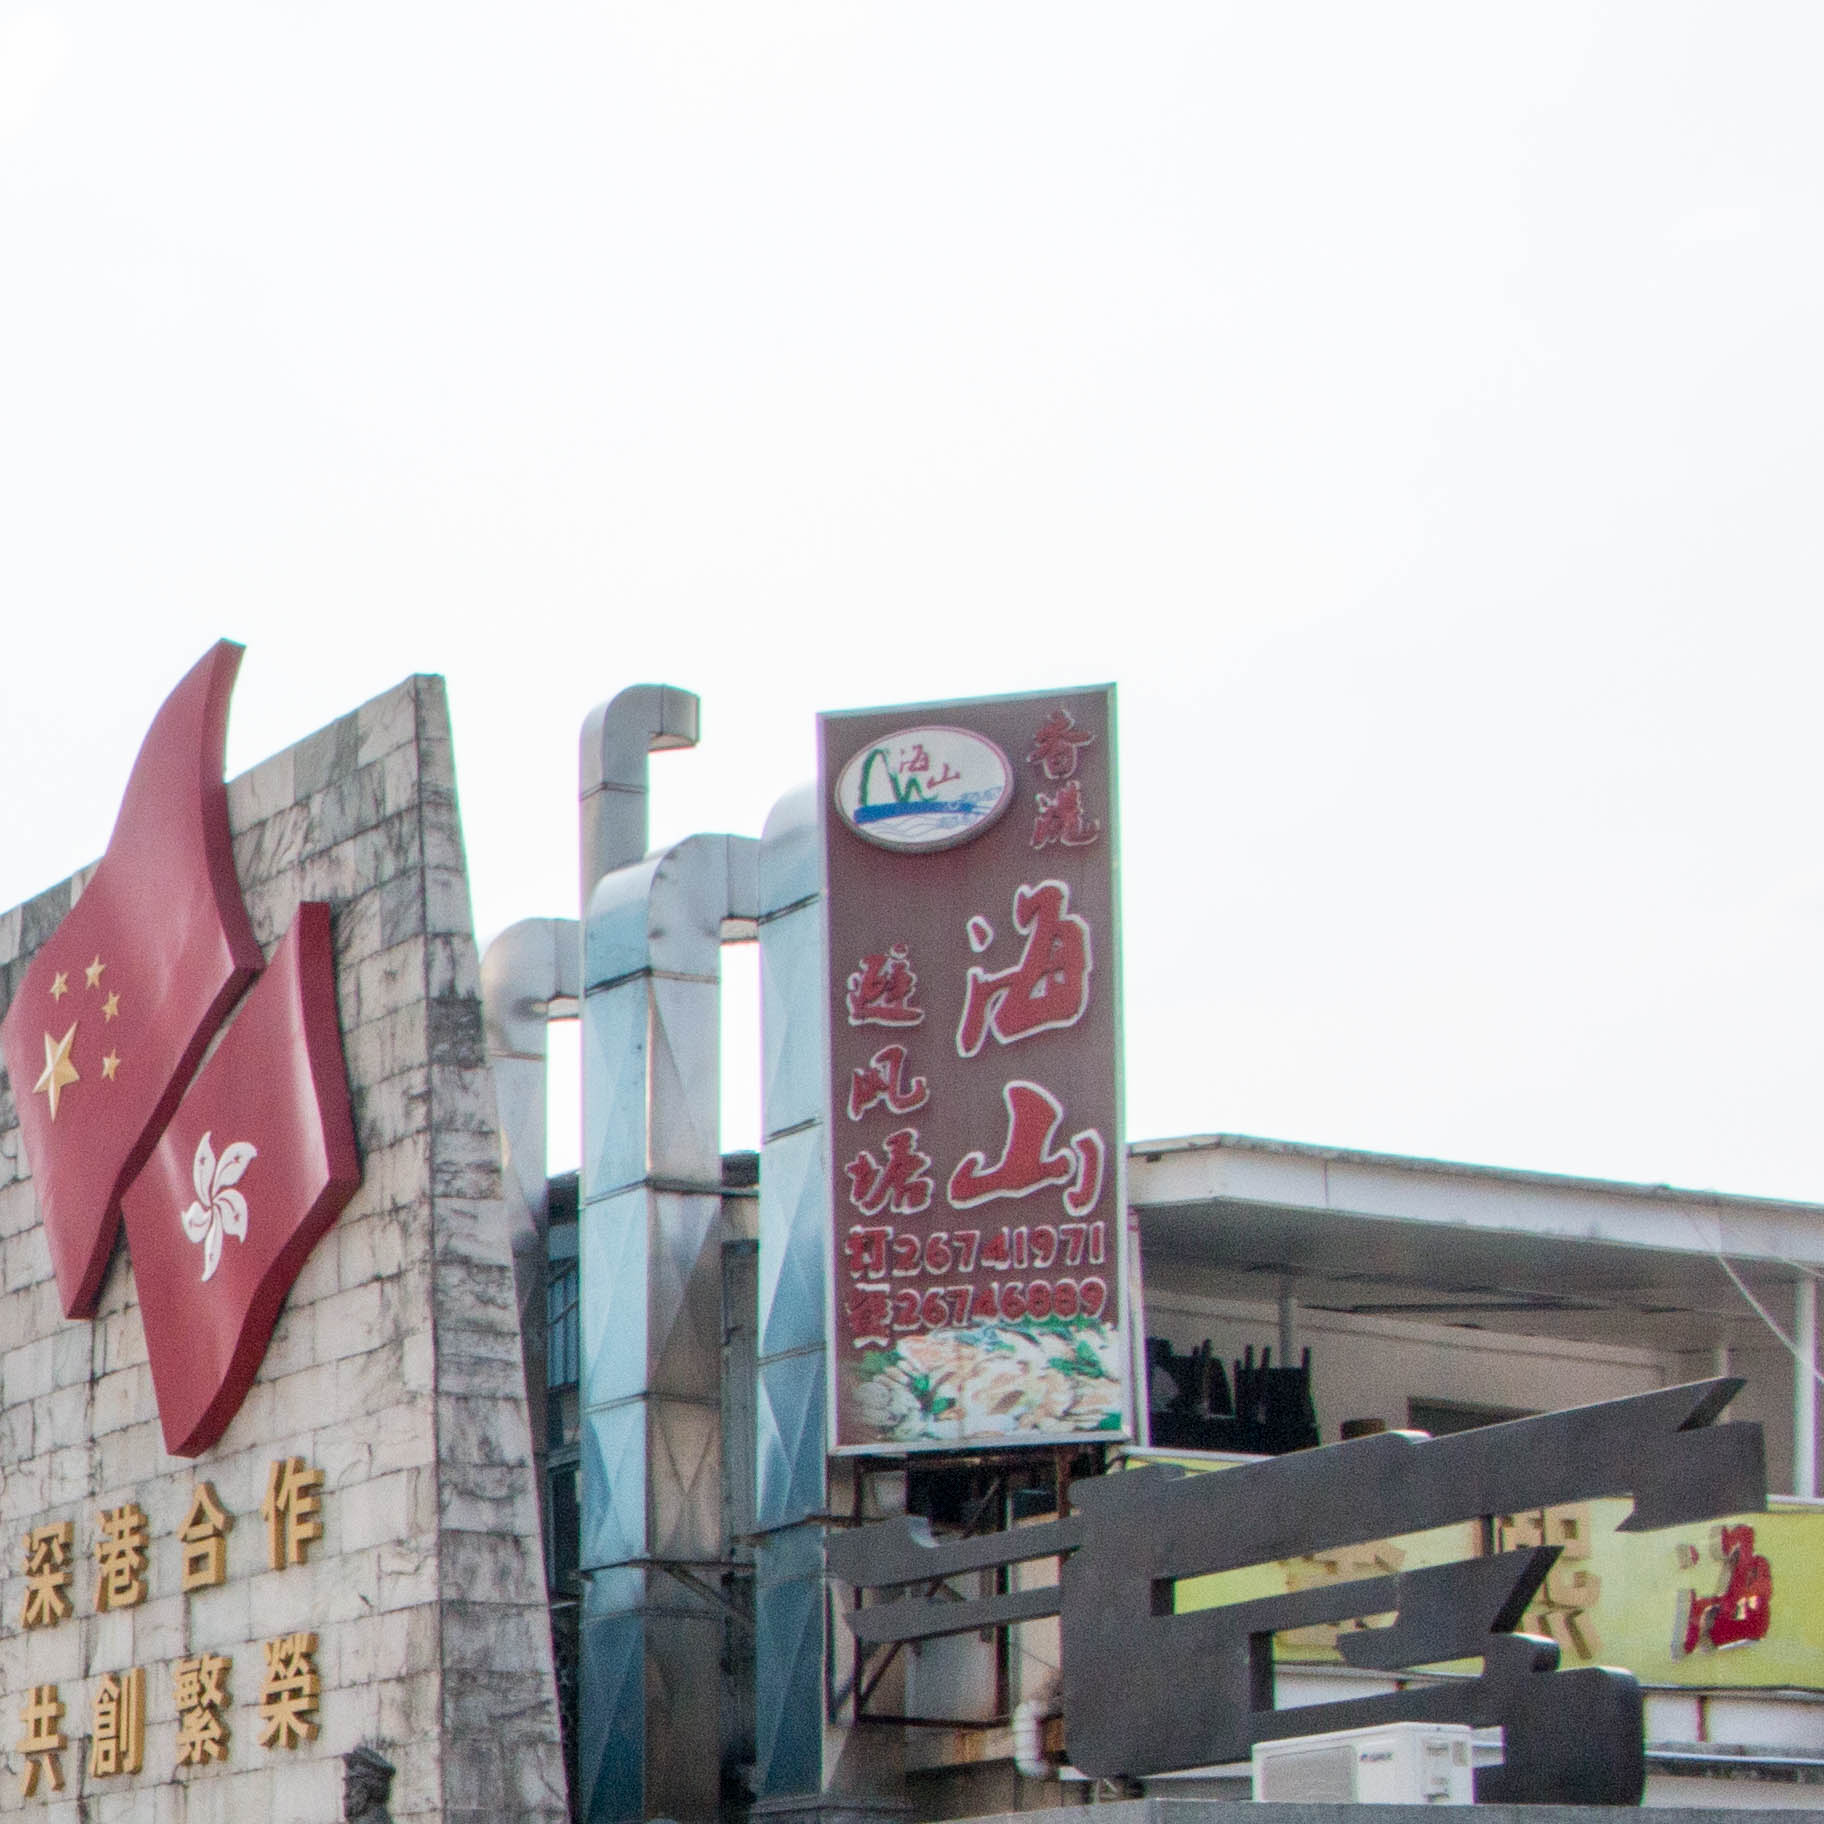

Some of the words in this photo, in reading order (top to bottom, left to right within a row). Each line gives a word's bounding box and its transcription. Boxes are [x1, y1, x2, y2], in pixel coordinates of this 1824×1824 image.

[947, 879, 1105, 1217] 海山
[892, 1220, 1107, 1276] 26741971
[892, 1276, 1108, 1331] 26746889
[20, 1455, 326, 1630] 深港合作
[16, 1631, 321, 1799] 共創繁榮
